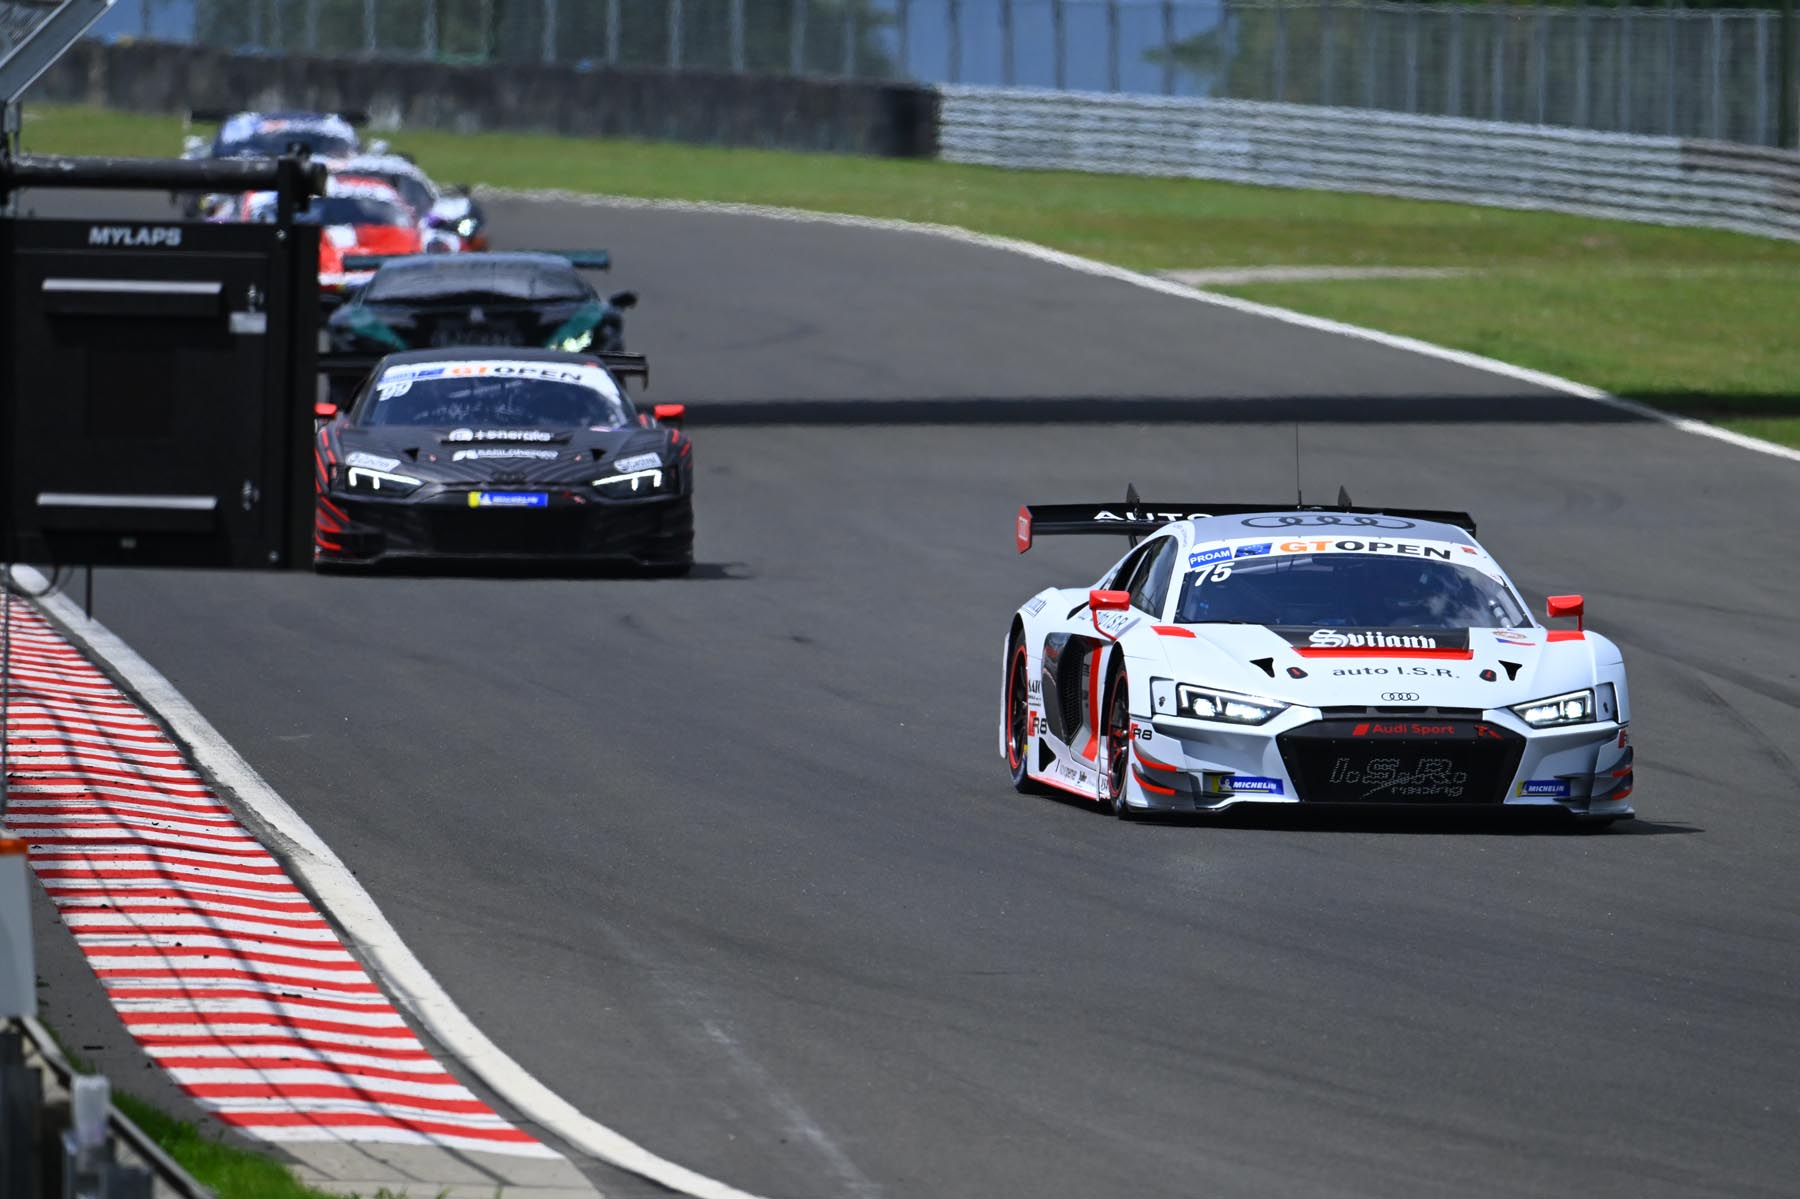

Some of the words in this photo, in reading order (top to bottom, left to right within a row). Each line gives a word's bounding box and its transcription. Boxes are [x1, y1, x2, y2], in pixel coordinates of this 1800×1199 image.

[89, 226, 182, 246] MYLAPS
[1189, 549, 1231, 565] PROAM
[1194, 561, 1235, 587] 75
[1332, 666, 1388, 677] auto
[1397, 666, 1460, 679] I.S.R.
[1372, 723, 1408, 734] Audi
[1411, 723, 1455, 737] Sport
[1232, 780, 1277, 790] MICHELIN
[1527, 784, 1565, 792] MICHELIN
